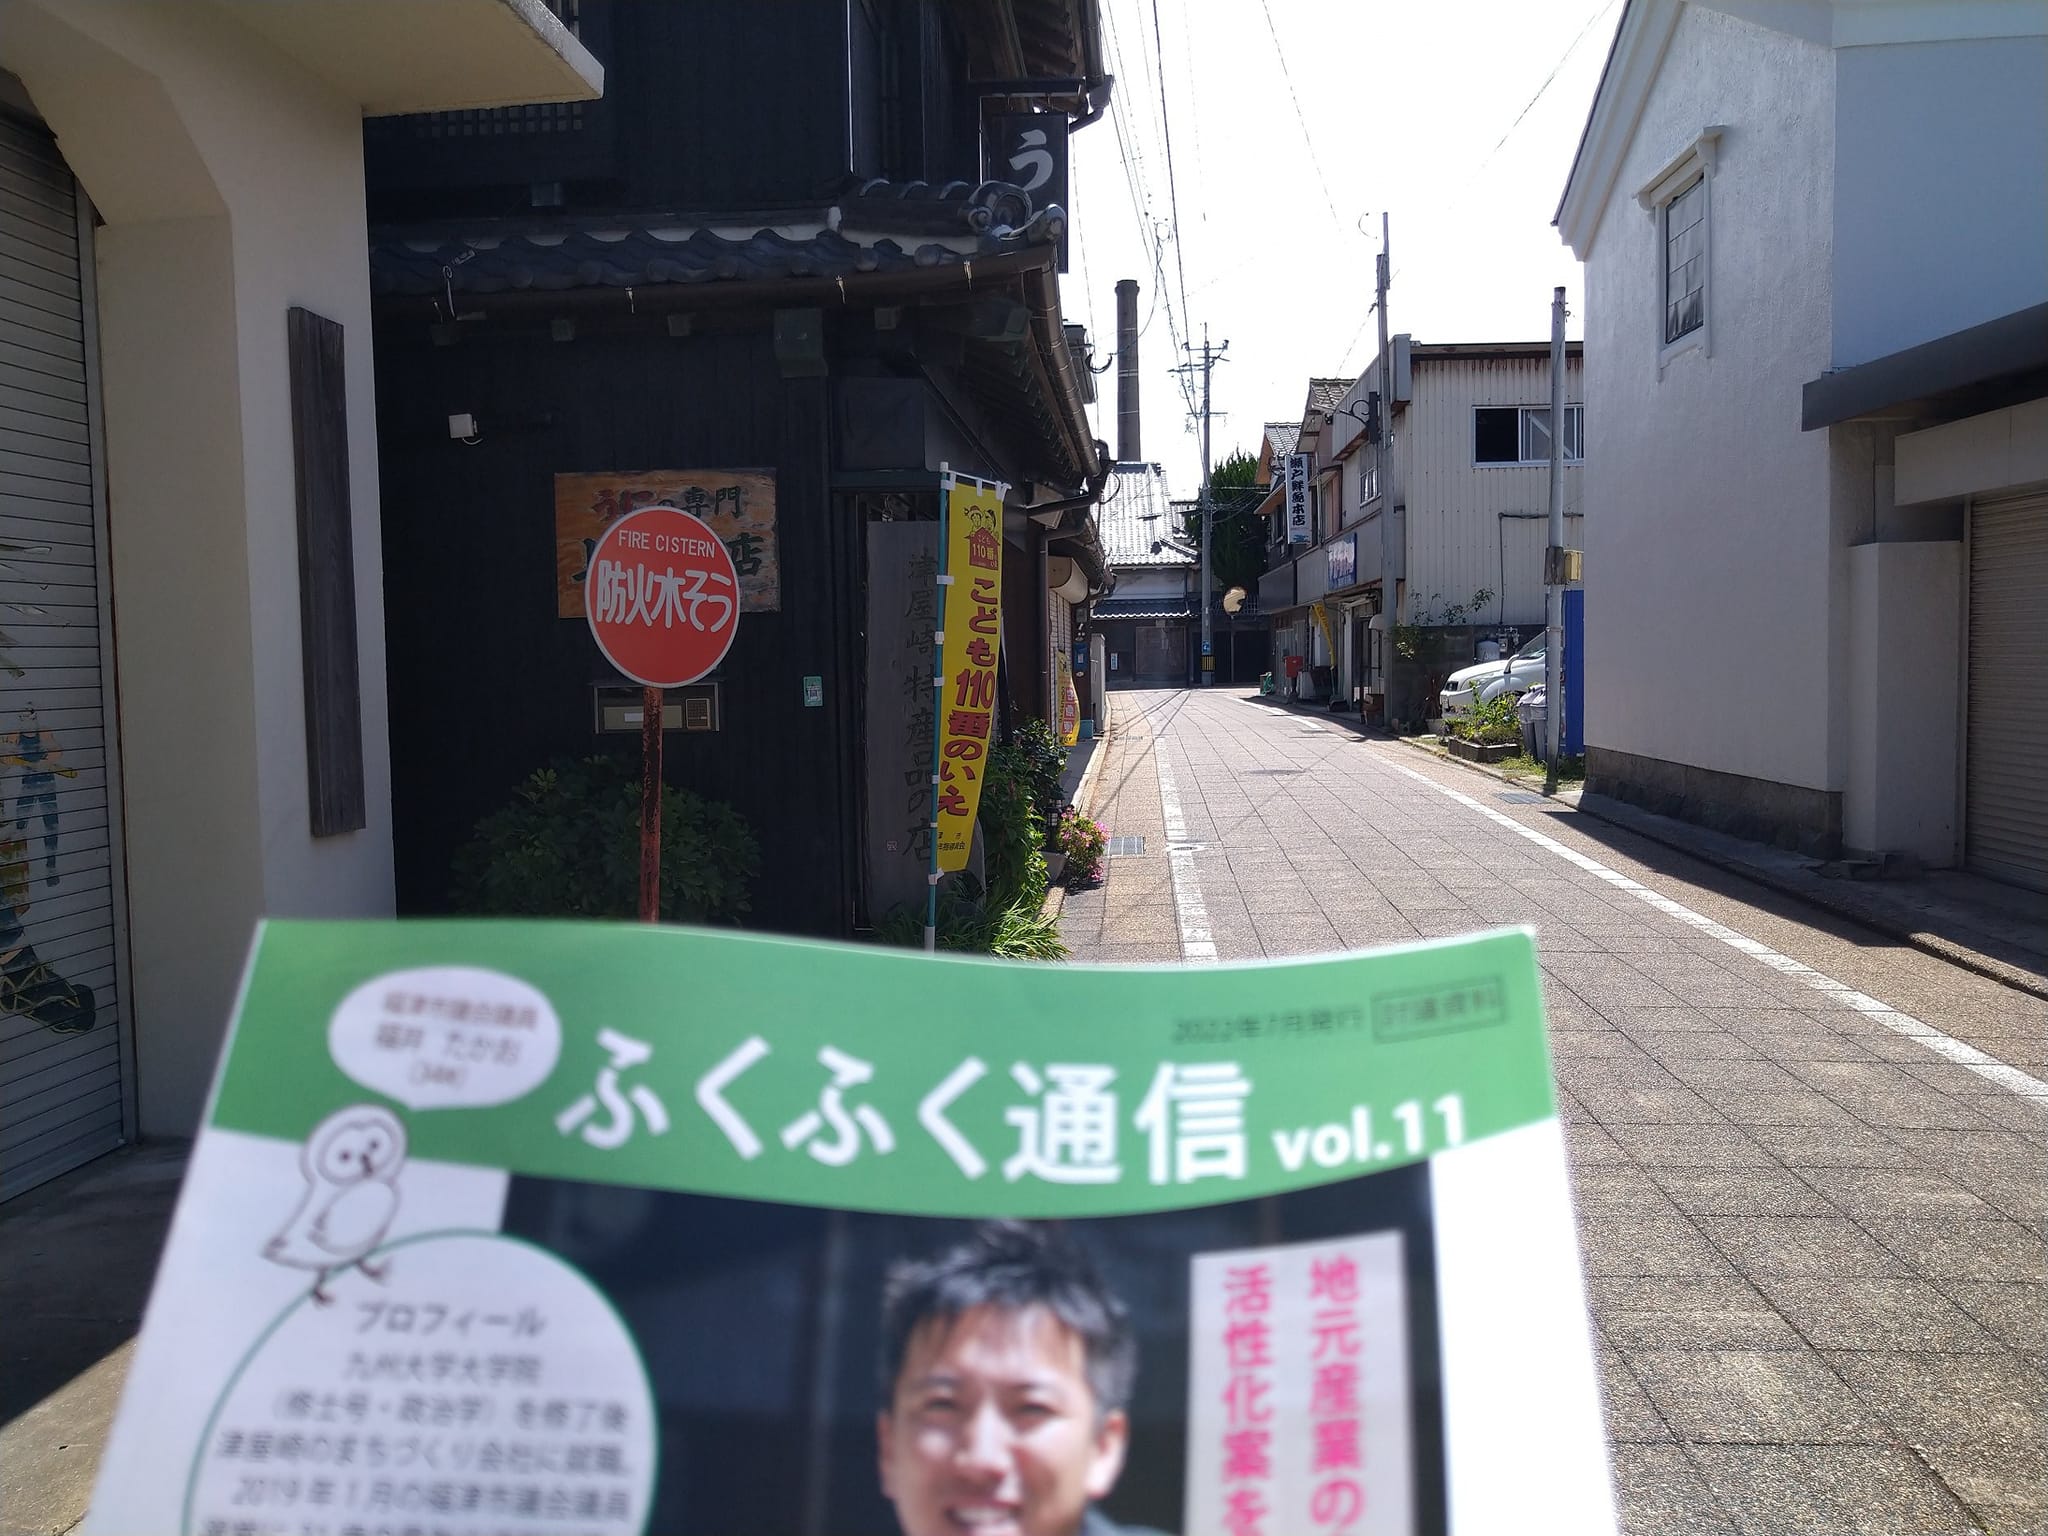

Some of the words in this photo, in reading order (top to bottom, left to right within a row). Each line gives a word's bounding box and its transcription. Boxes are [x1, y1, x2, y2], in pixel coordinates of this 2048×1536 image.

[1009, 129, 1054, 192] う
[618, 530, 651, 550] FIRE
[655, 534, 716, 559] CISTERN
[938, 578, 998, 817] こども110番のいえ
[555, 1027, 1253, 1186] ふくふく通信
[1272, 1093, 1466, 1173] vol.11
[355, 1302, 549, 1338] プロフィール
[1309, 1255, 1366, 1527] 地元産業の
